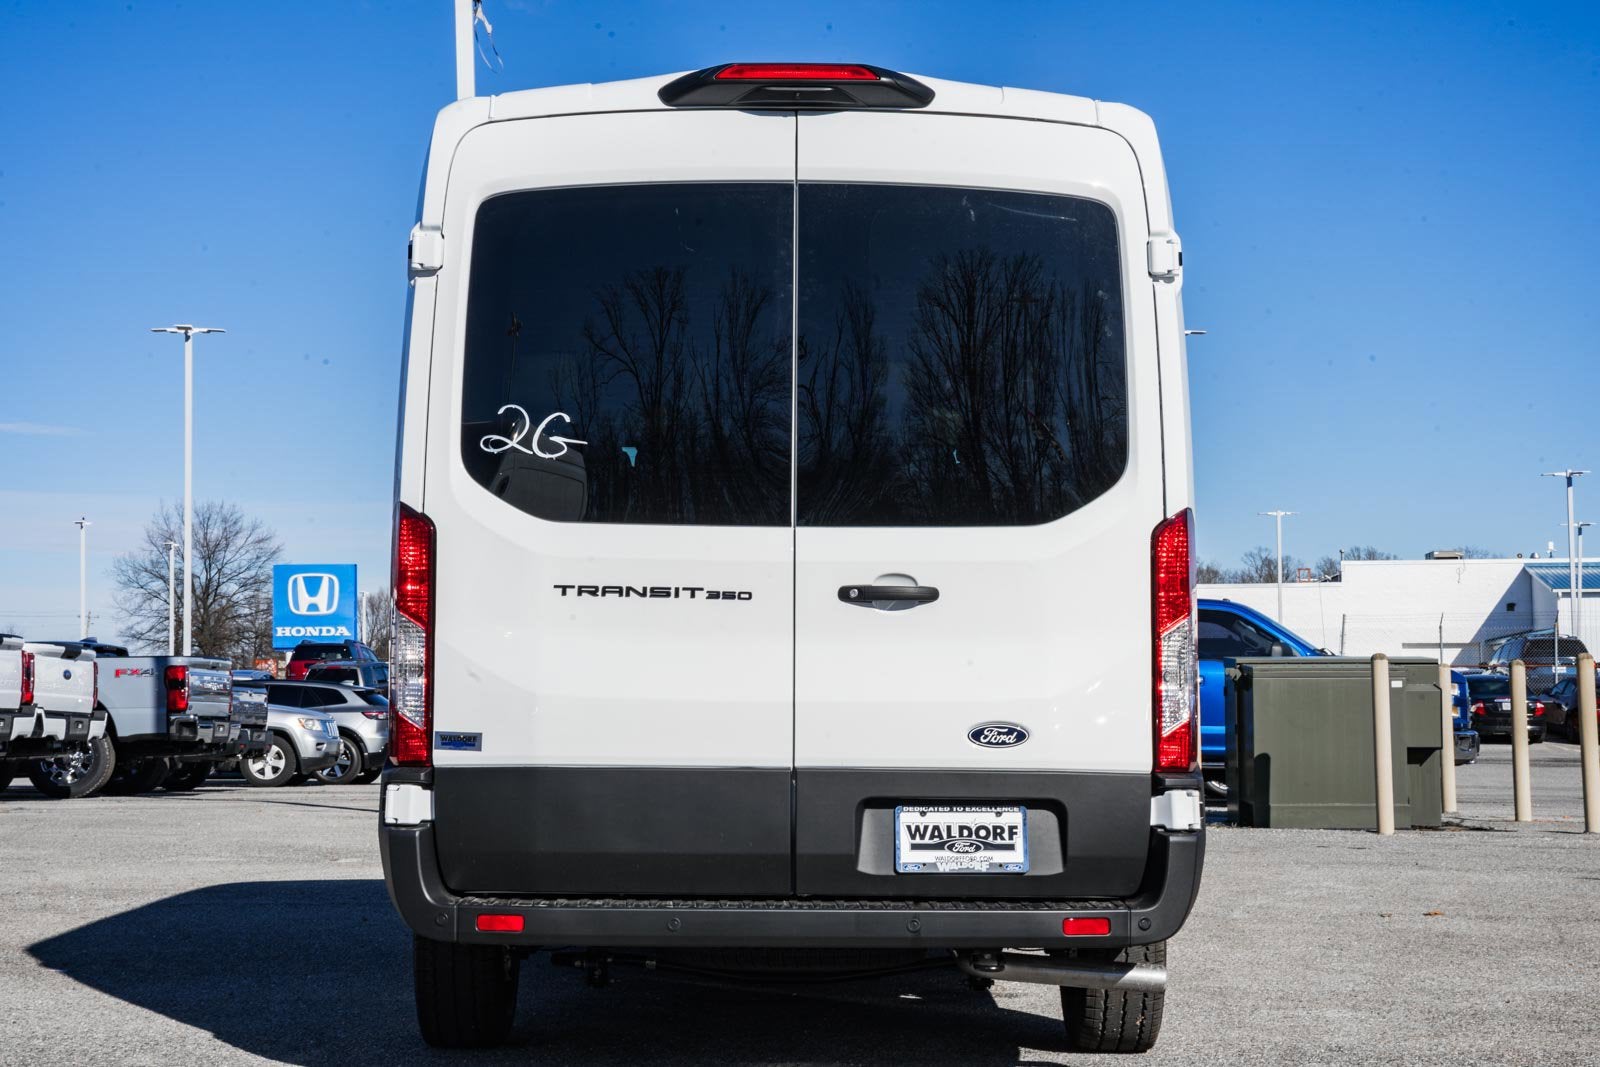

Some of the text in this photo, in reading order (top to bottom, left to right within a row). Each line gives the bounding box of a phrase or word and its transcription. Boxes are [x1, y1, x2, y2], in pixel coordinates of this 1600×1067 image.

[275, 626, 352, 637] HONDA
[115, 668, 155, 677] FX4
[980, 727, 1018, 743] Ford
[905, 825, 1019, 841] WALDORF
[952, 842, 976, 853] Ford
